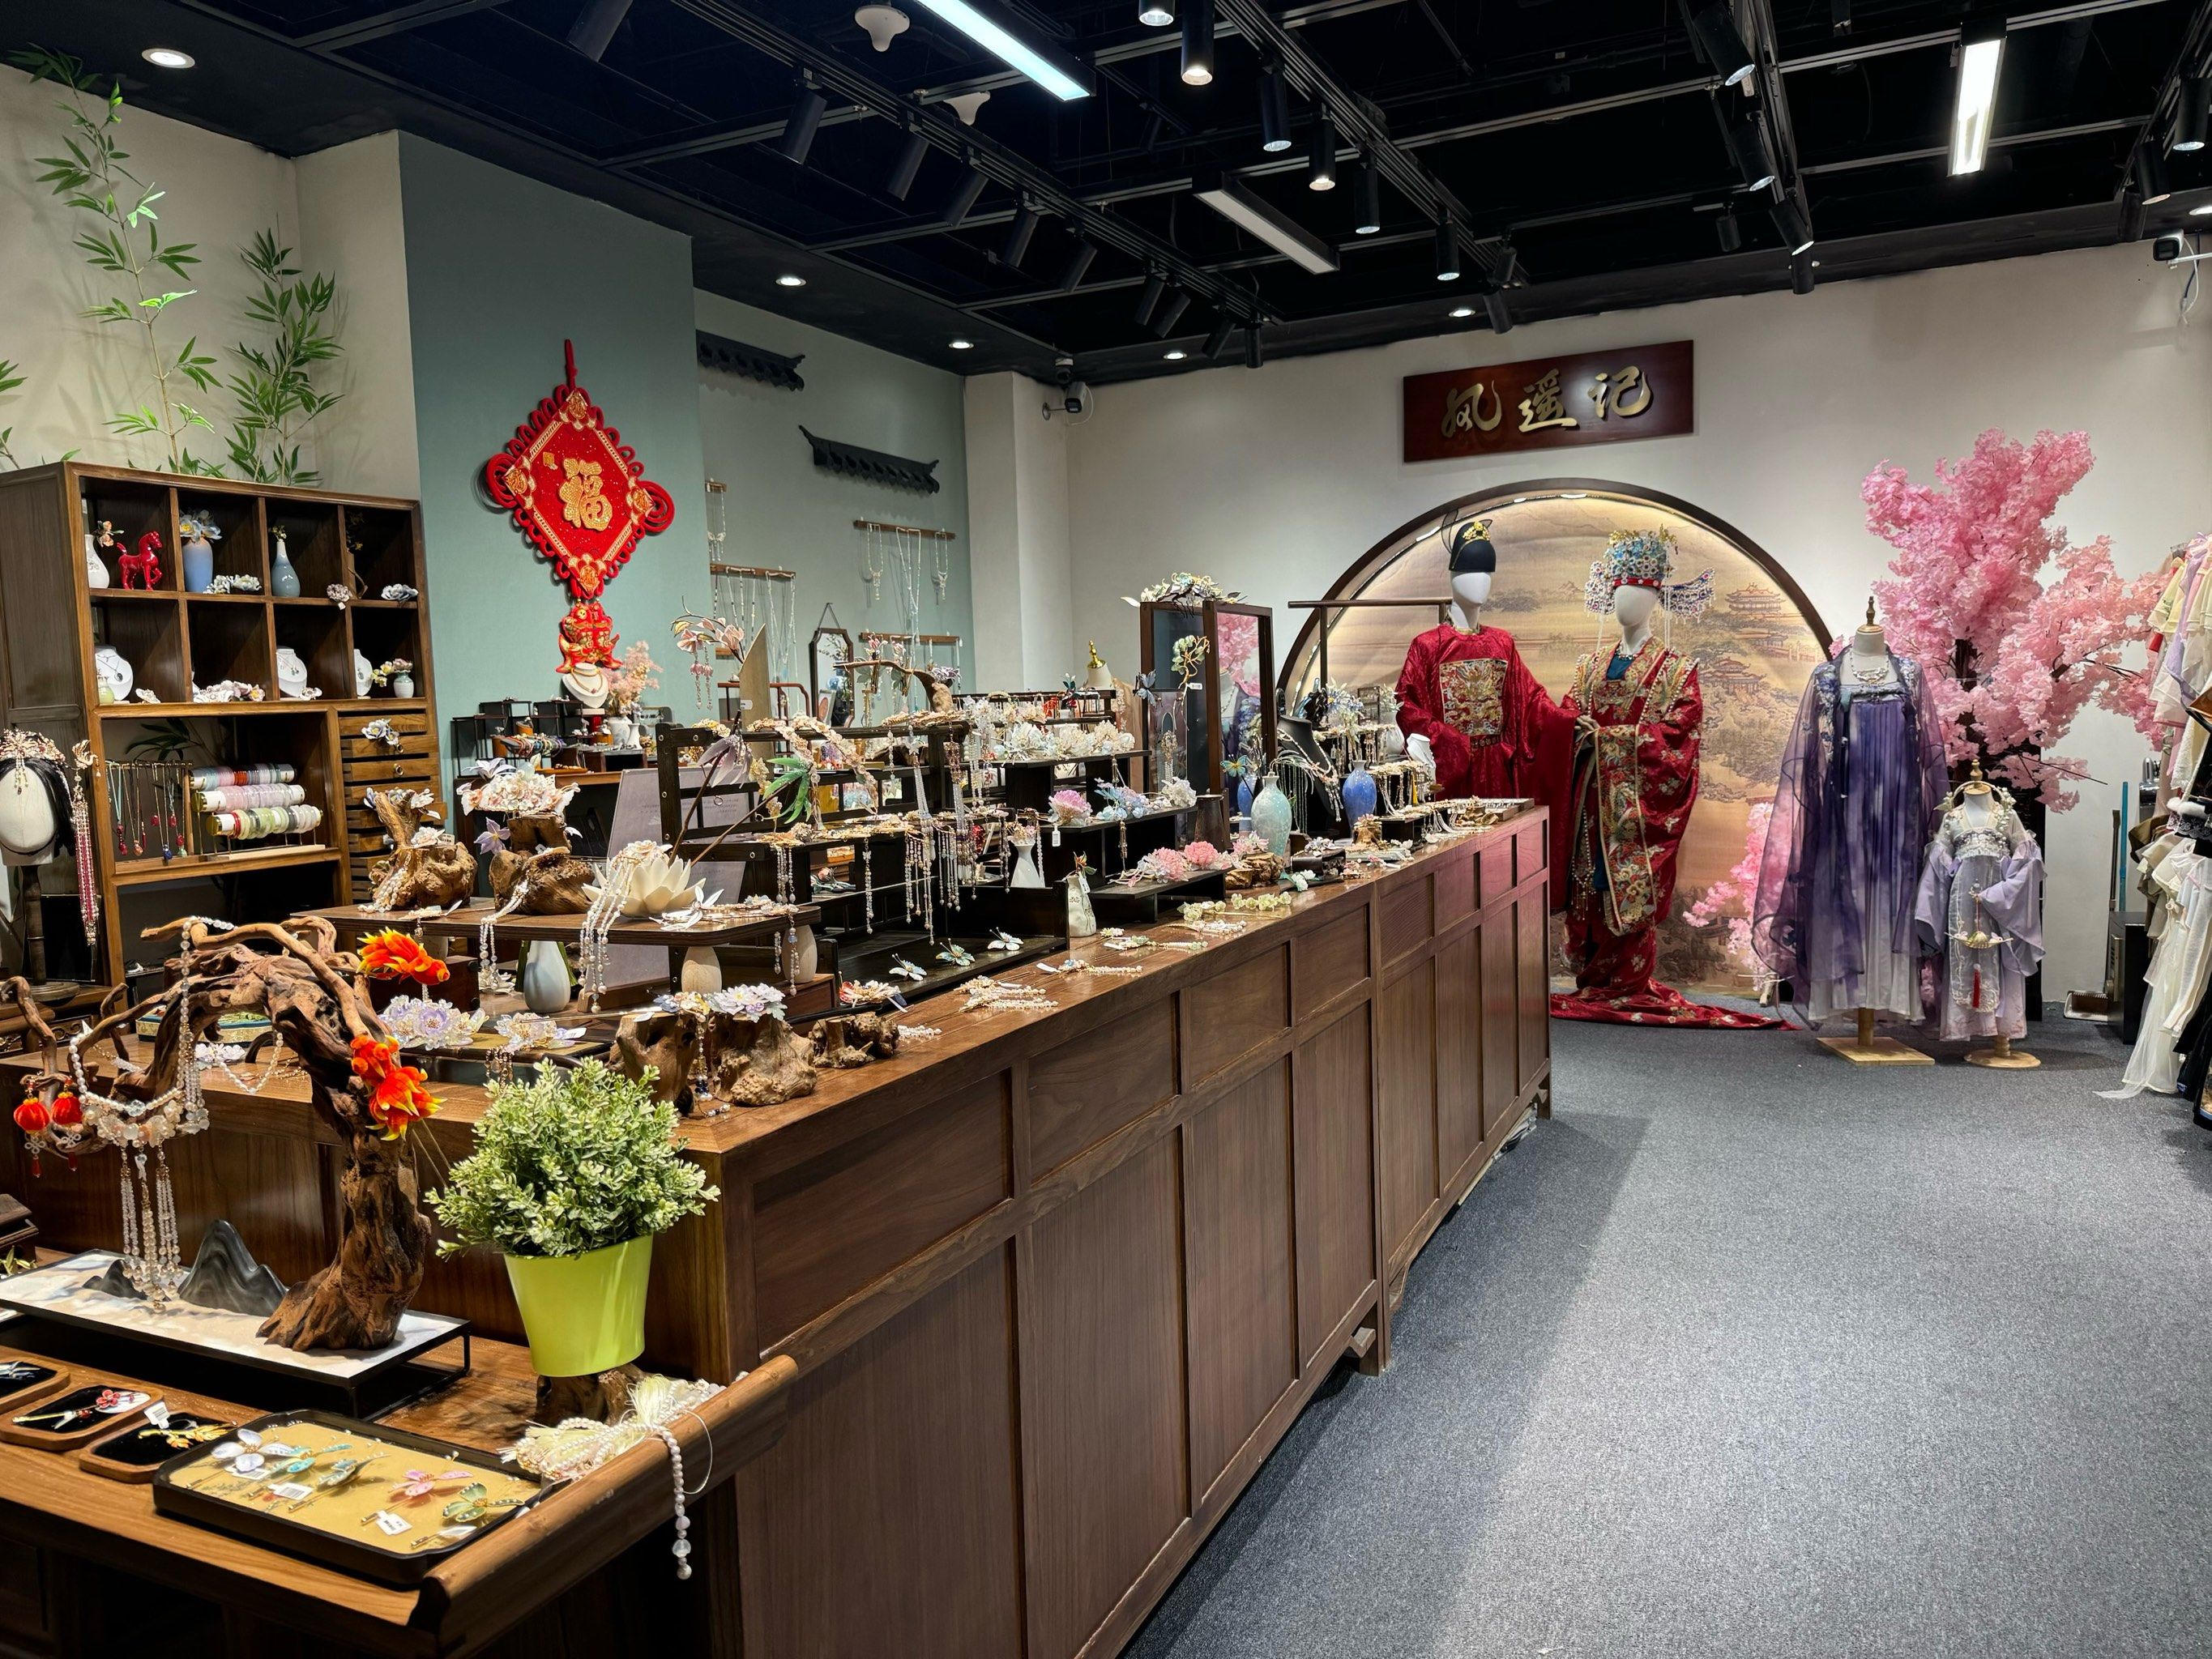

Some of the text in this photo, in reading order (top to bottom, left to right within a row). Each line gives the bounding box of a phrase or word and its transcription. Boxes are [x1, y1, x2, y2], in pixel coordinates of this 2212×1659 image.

[1441, 365, 1651, 437] 风遥记
[559, 458, 613, 531] 福
